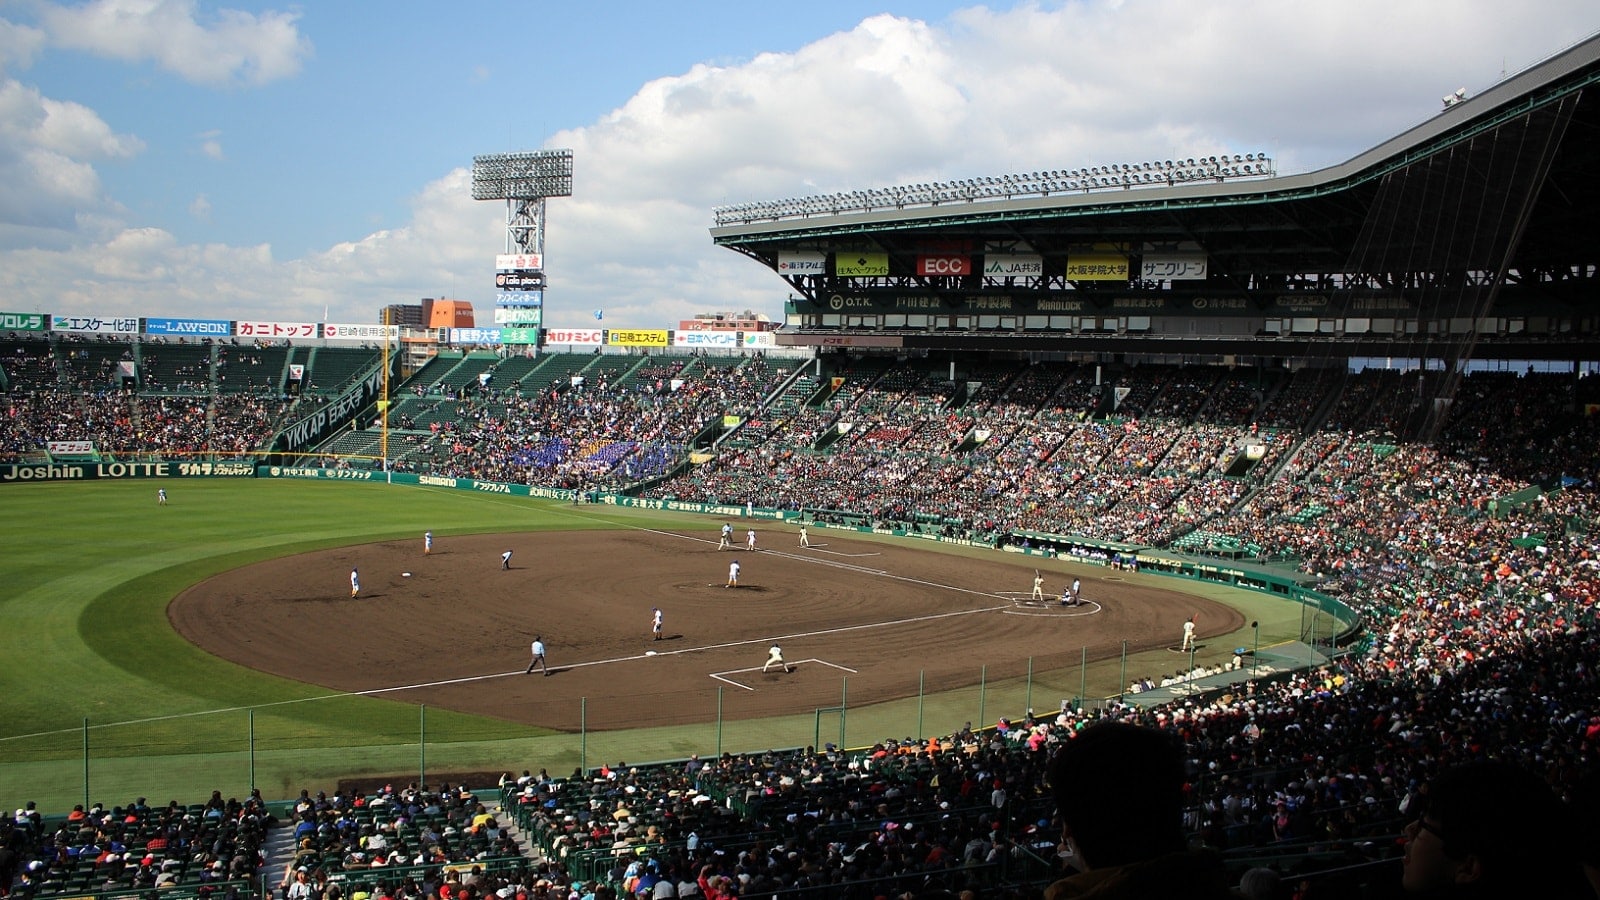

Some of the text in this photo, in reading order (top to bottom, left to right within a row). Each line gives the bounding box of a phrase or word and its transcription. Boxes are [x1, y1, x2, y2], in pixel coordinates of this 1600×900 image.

[837, 267, 889, 275] 住友ベークライト
[924, 258, 963, 274] ECC
[1006, 261, 1041, 273] JA共済
[1068, 264, 1127, 276] 大阪学院大学
[1143, 263, 1206, 277] サニクリーン
[845, 297, 873, 307] O.T.K.
[69, 317, 137, 332] エスケー化研
[166, 321, 228, 333] LAWSON
[240, 322, 315, 337] カニトップ
[548, 332, 601, 343] オロナミンC
[619, 333, 666, 343] 日商エステム
[687, 334, 736, 344] 日本ペイント
[328, 384, 364, 426] 日本大学
[286, 411, 326, 450] YKK AP
[4, 464, 83, 480] Joshin
[97, 463, 170, 477] LOTTE
[178, 463, 213, 476] タカラ
[283, 468, 319, 477] 竹中工務店
[419, 475, 457, 488] SHIMANO
[529, 486, 582, 502] 武庫川女子大
